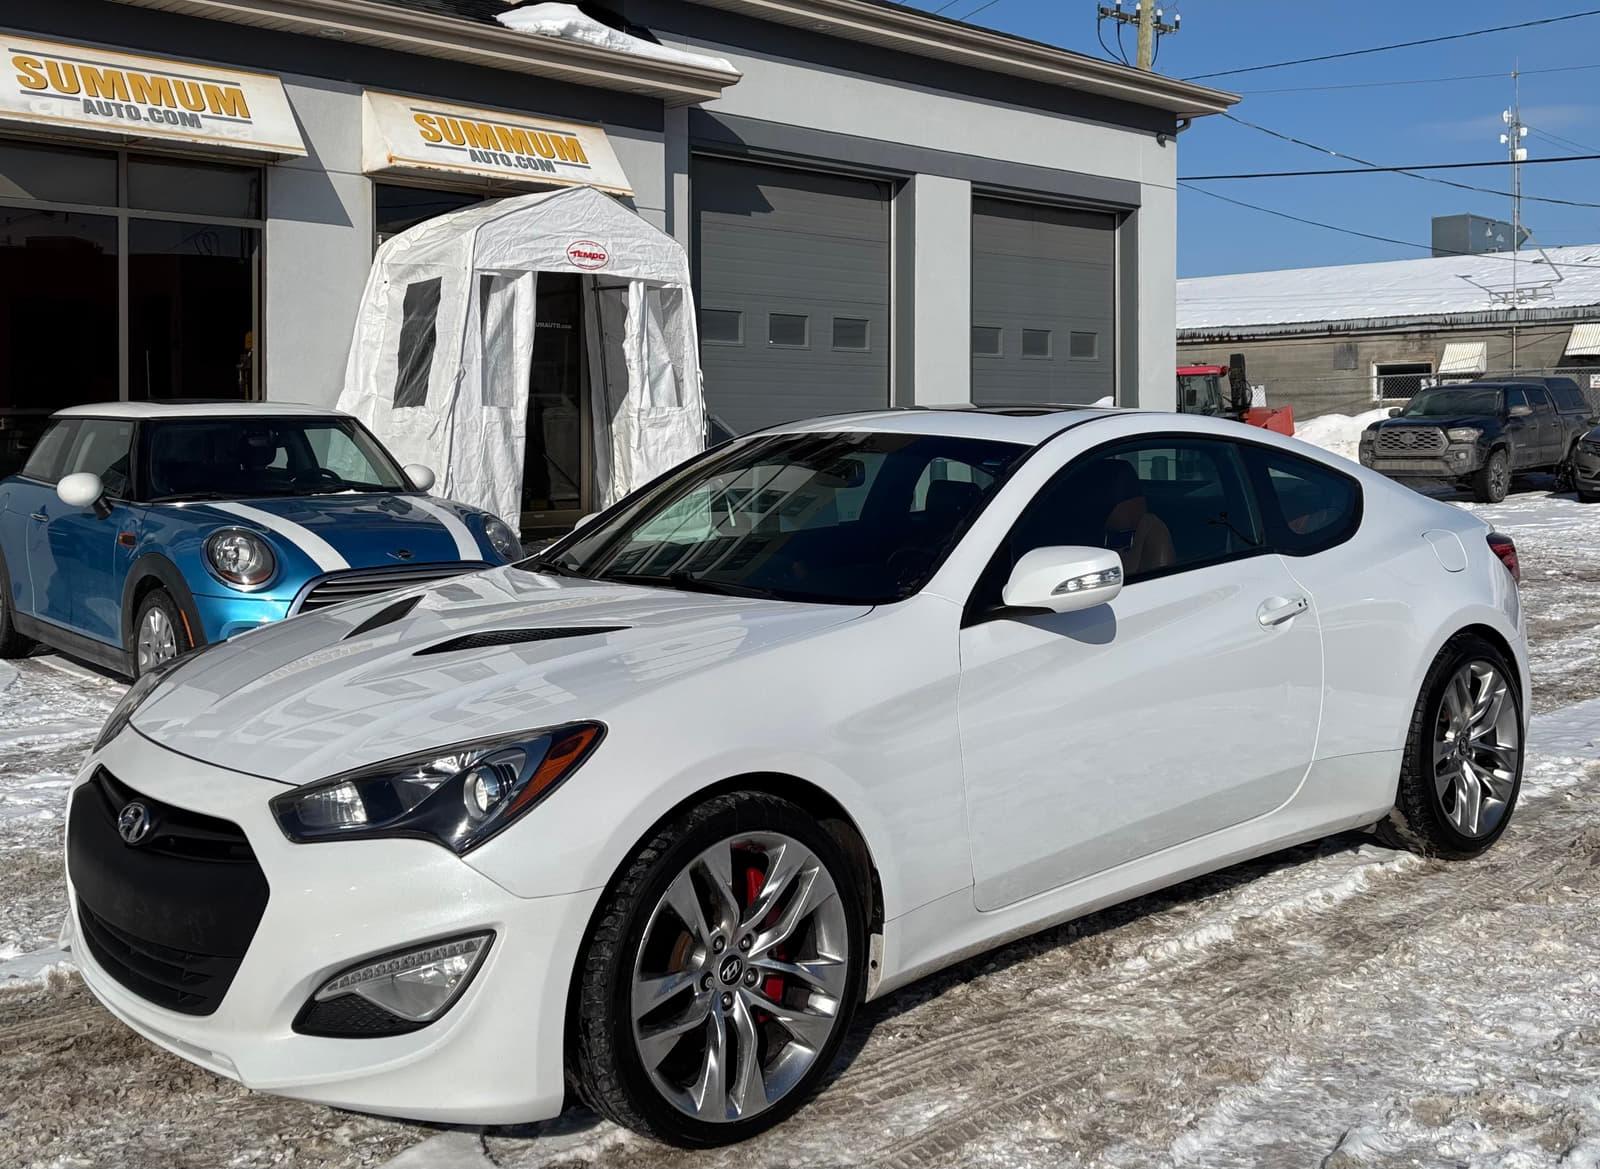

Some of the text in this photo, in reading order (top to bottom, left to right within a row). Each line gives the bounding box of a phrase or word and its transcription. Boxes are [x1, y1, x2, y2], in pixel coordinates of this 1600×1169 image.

[11, 55, 251, 118] SUMMUM
[83, 99, 202, 129] AUTO.COM
[413, 113, 589, 164] SUMMUM
[470, 150, 556, 173] AUTO.COM
[569, 250, 606, 261] TEMPO
